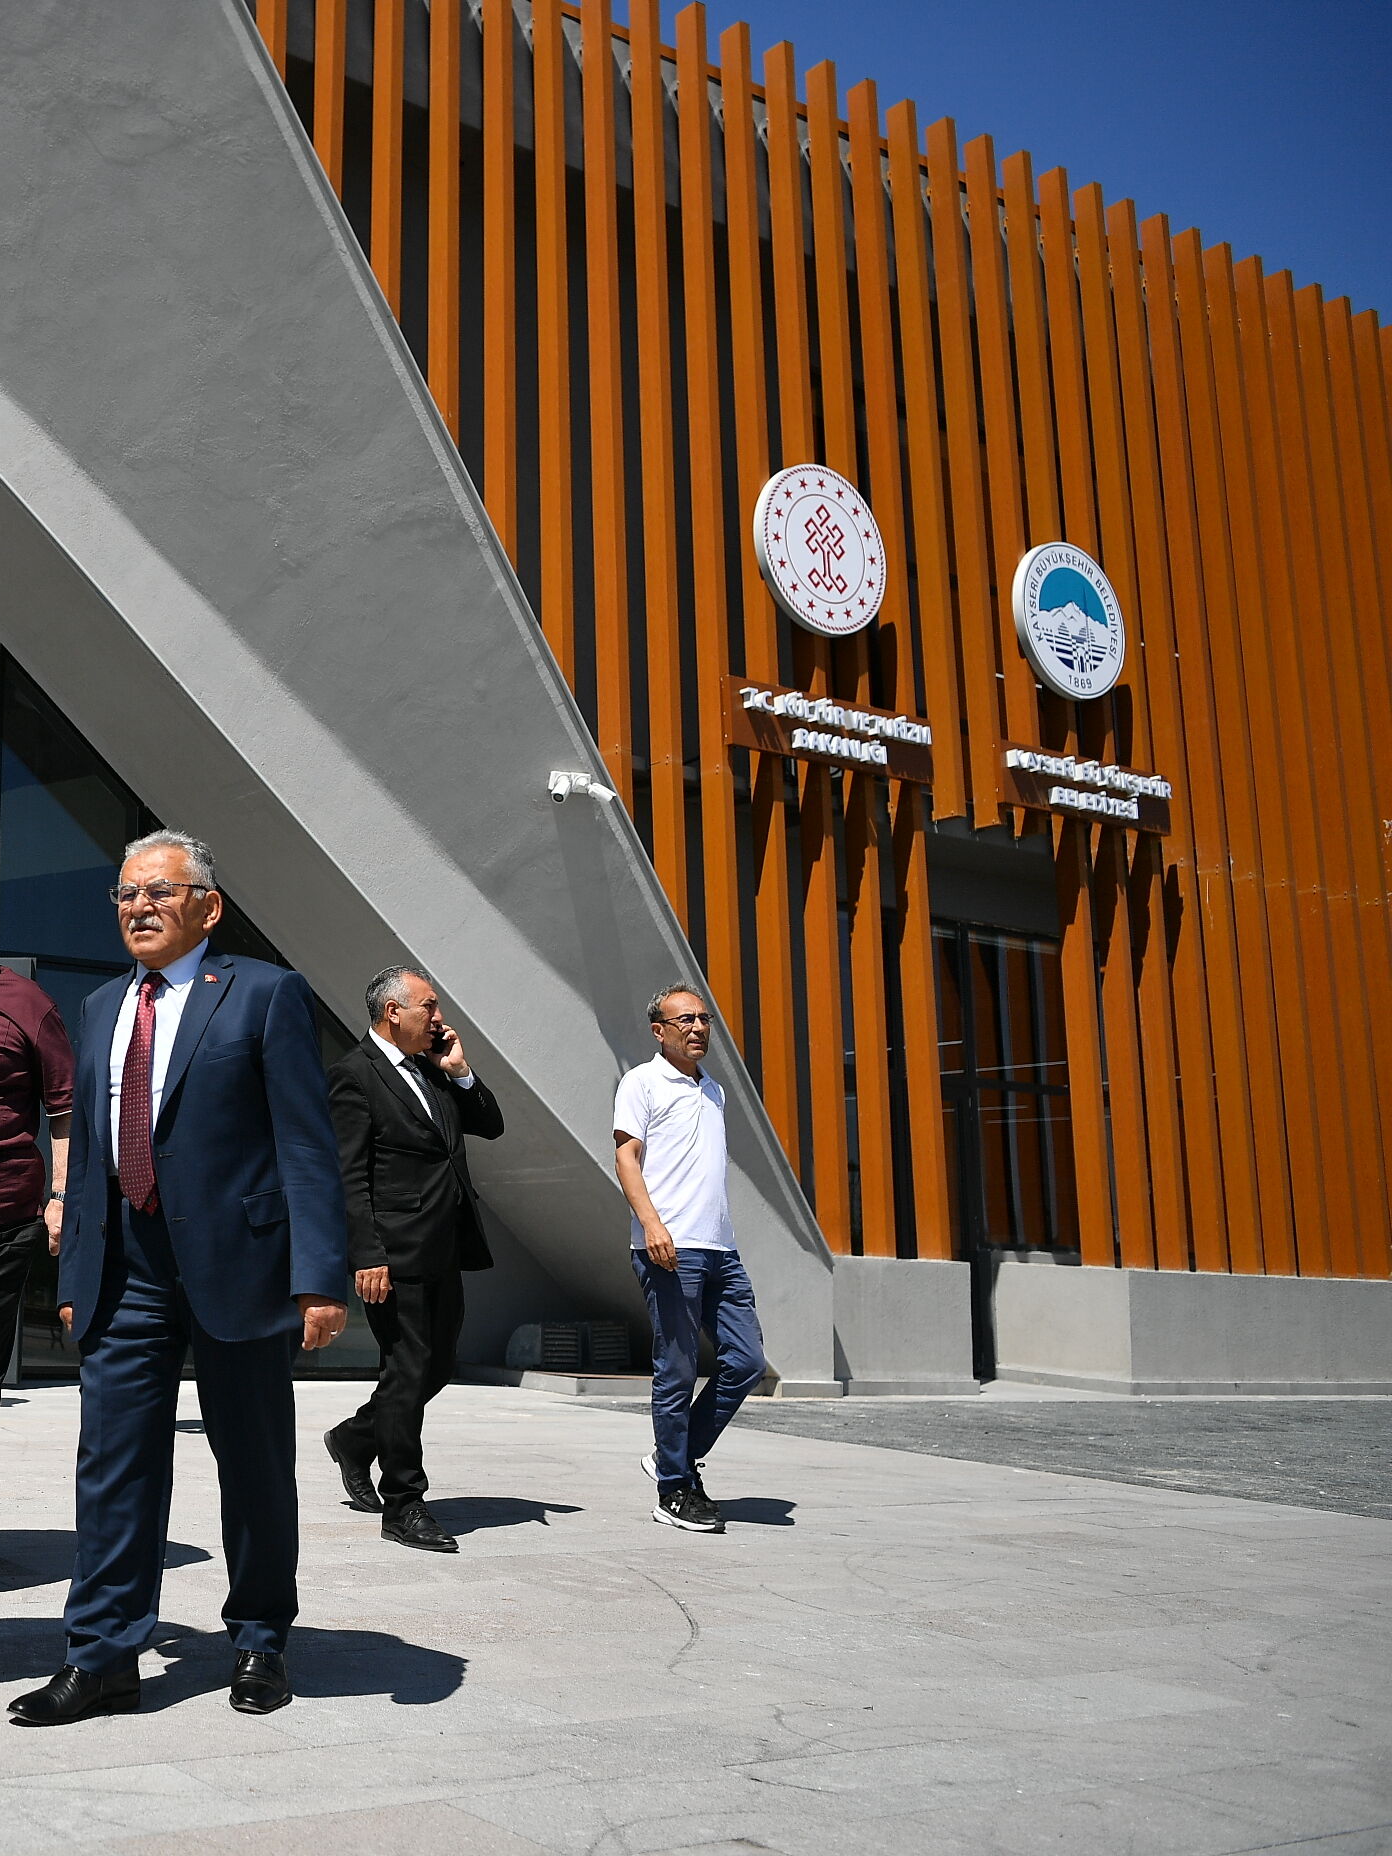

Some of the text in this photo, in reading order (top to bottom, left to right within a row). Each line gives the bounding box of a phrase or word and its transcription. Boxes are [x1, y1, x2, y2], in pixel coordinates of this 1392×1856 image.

[1036, 551, 1094, 578] BÜYÜKŞEHİR
[1030, 576, 1043, 642] KAYSERİ
[1068, 674, 1093, 689] 1869
[844, 709, 870, 732] VE
[792, 727, 887, 764] BAKANLIĞI
